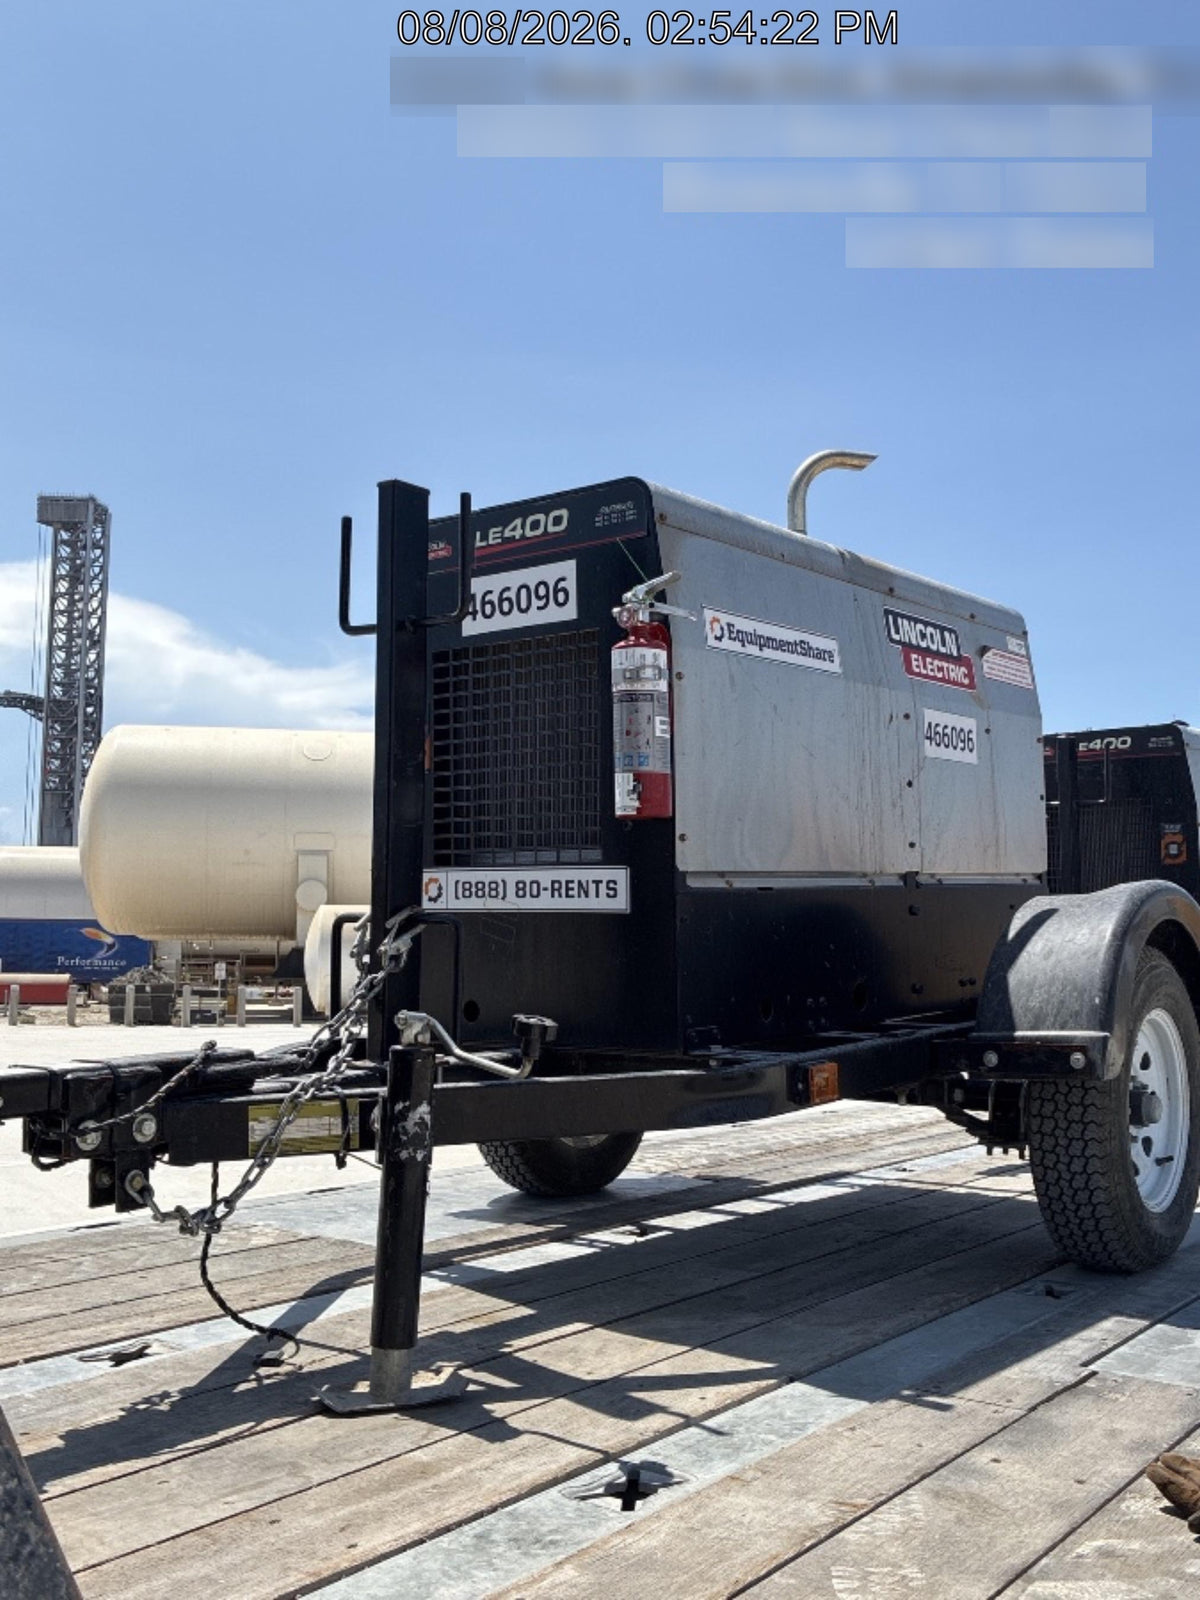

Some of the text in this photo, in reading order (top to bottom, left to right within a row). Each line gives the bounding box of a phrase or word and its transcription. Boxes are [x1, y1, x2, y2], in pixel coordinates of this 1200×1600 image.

[475, 508, 569, 547] LE400
[468, 576, 570, 621] 466096
[726, 621, 835, 663] EquipmentShare
[888, 613, 958, 657] LINCOLN
[910, 652, 970, 686] ELECTRIC
[924, 721, 975, 753] 466096
[1078, 735, 1132, 751] E400
[454, 879, 618, 900] (888) 80-RENTS
[57, 955, 127, 967] Performance
